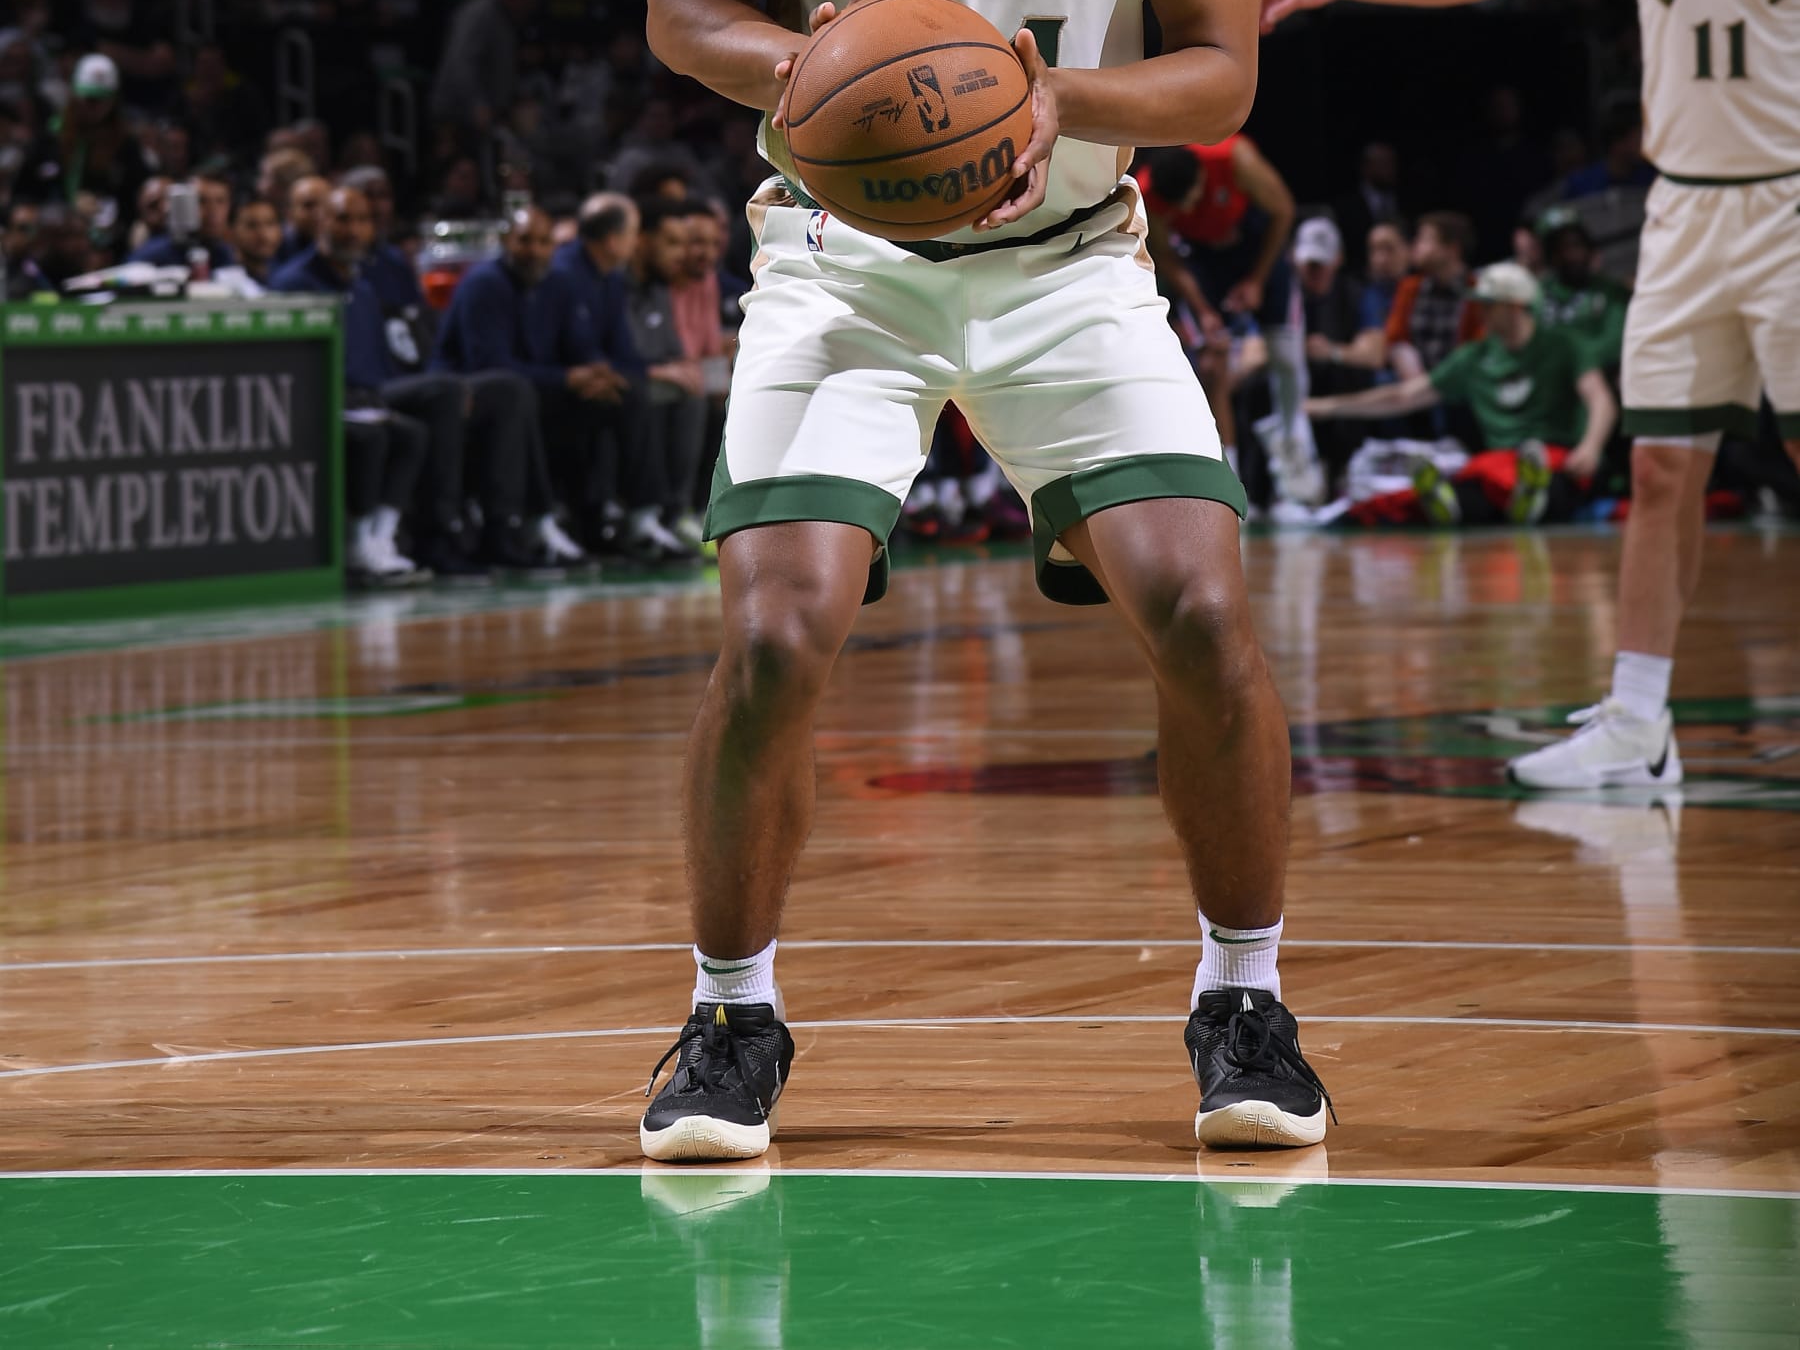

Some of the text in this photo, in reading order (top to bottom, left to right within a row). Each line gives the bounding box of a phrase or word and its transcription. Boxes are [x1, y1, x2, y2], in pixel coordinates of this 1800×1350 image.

[1692, 17, 1749, 80] 11
[861, 137, 1016, 204] Wilson
[15, 373, 294, 462] FRANKLIN
[3, 461, 317, 560] TEMPLETON
